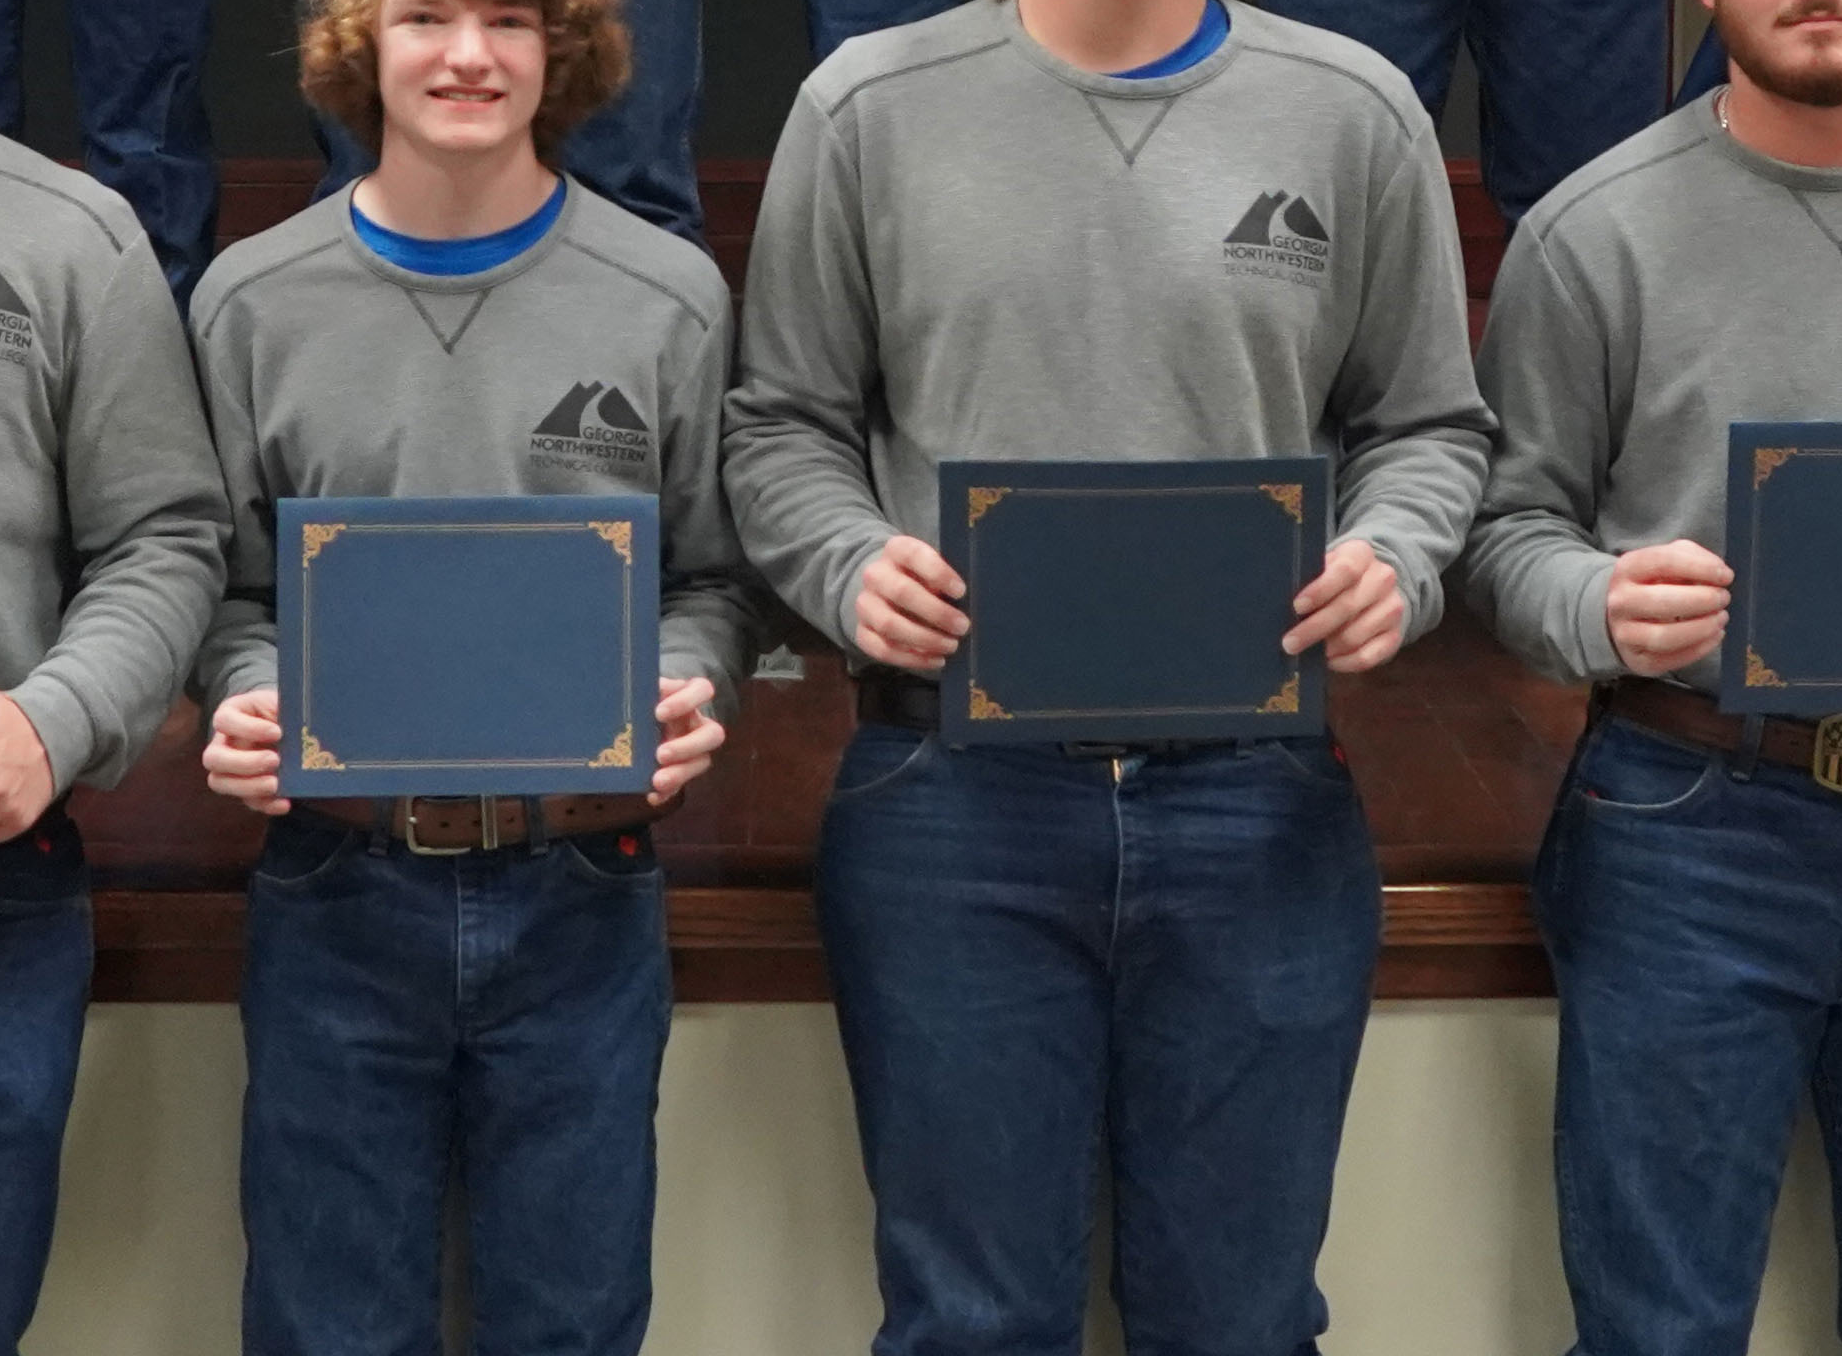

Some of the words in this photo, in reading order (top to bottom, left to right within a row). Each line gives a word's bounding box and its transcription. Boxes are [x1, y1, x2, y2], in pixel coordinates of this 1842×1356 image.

[1273, 235, 1329, 257] GEORGIA
[1223, 246, 1325, 272] NORTHWESTERN
[583, 426, 648, 448] GEORGIA
[530, 438, 647, 463] NORTHWESTERN
